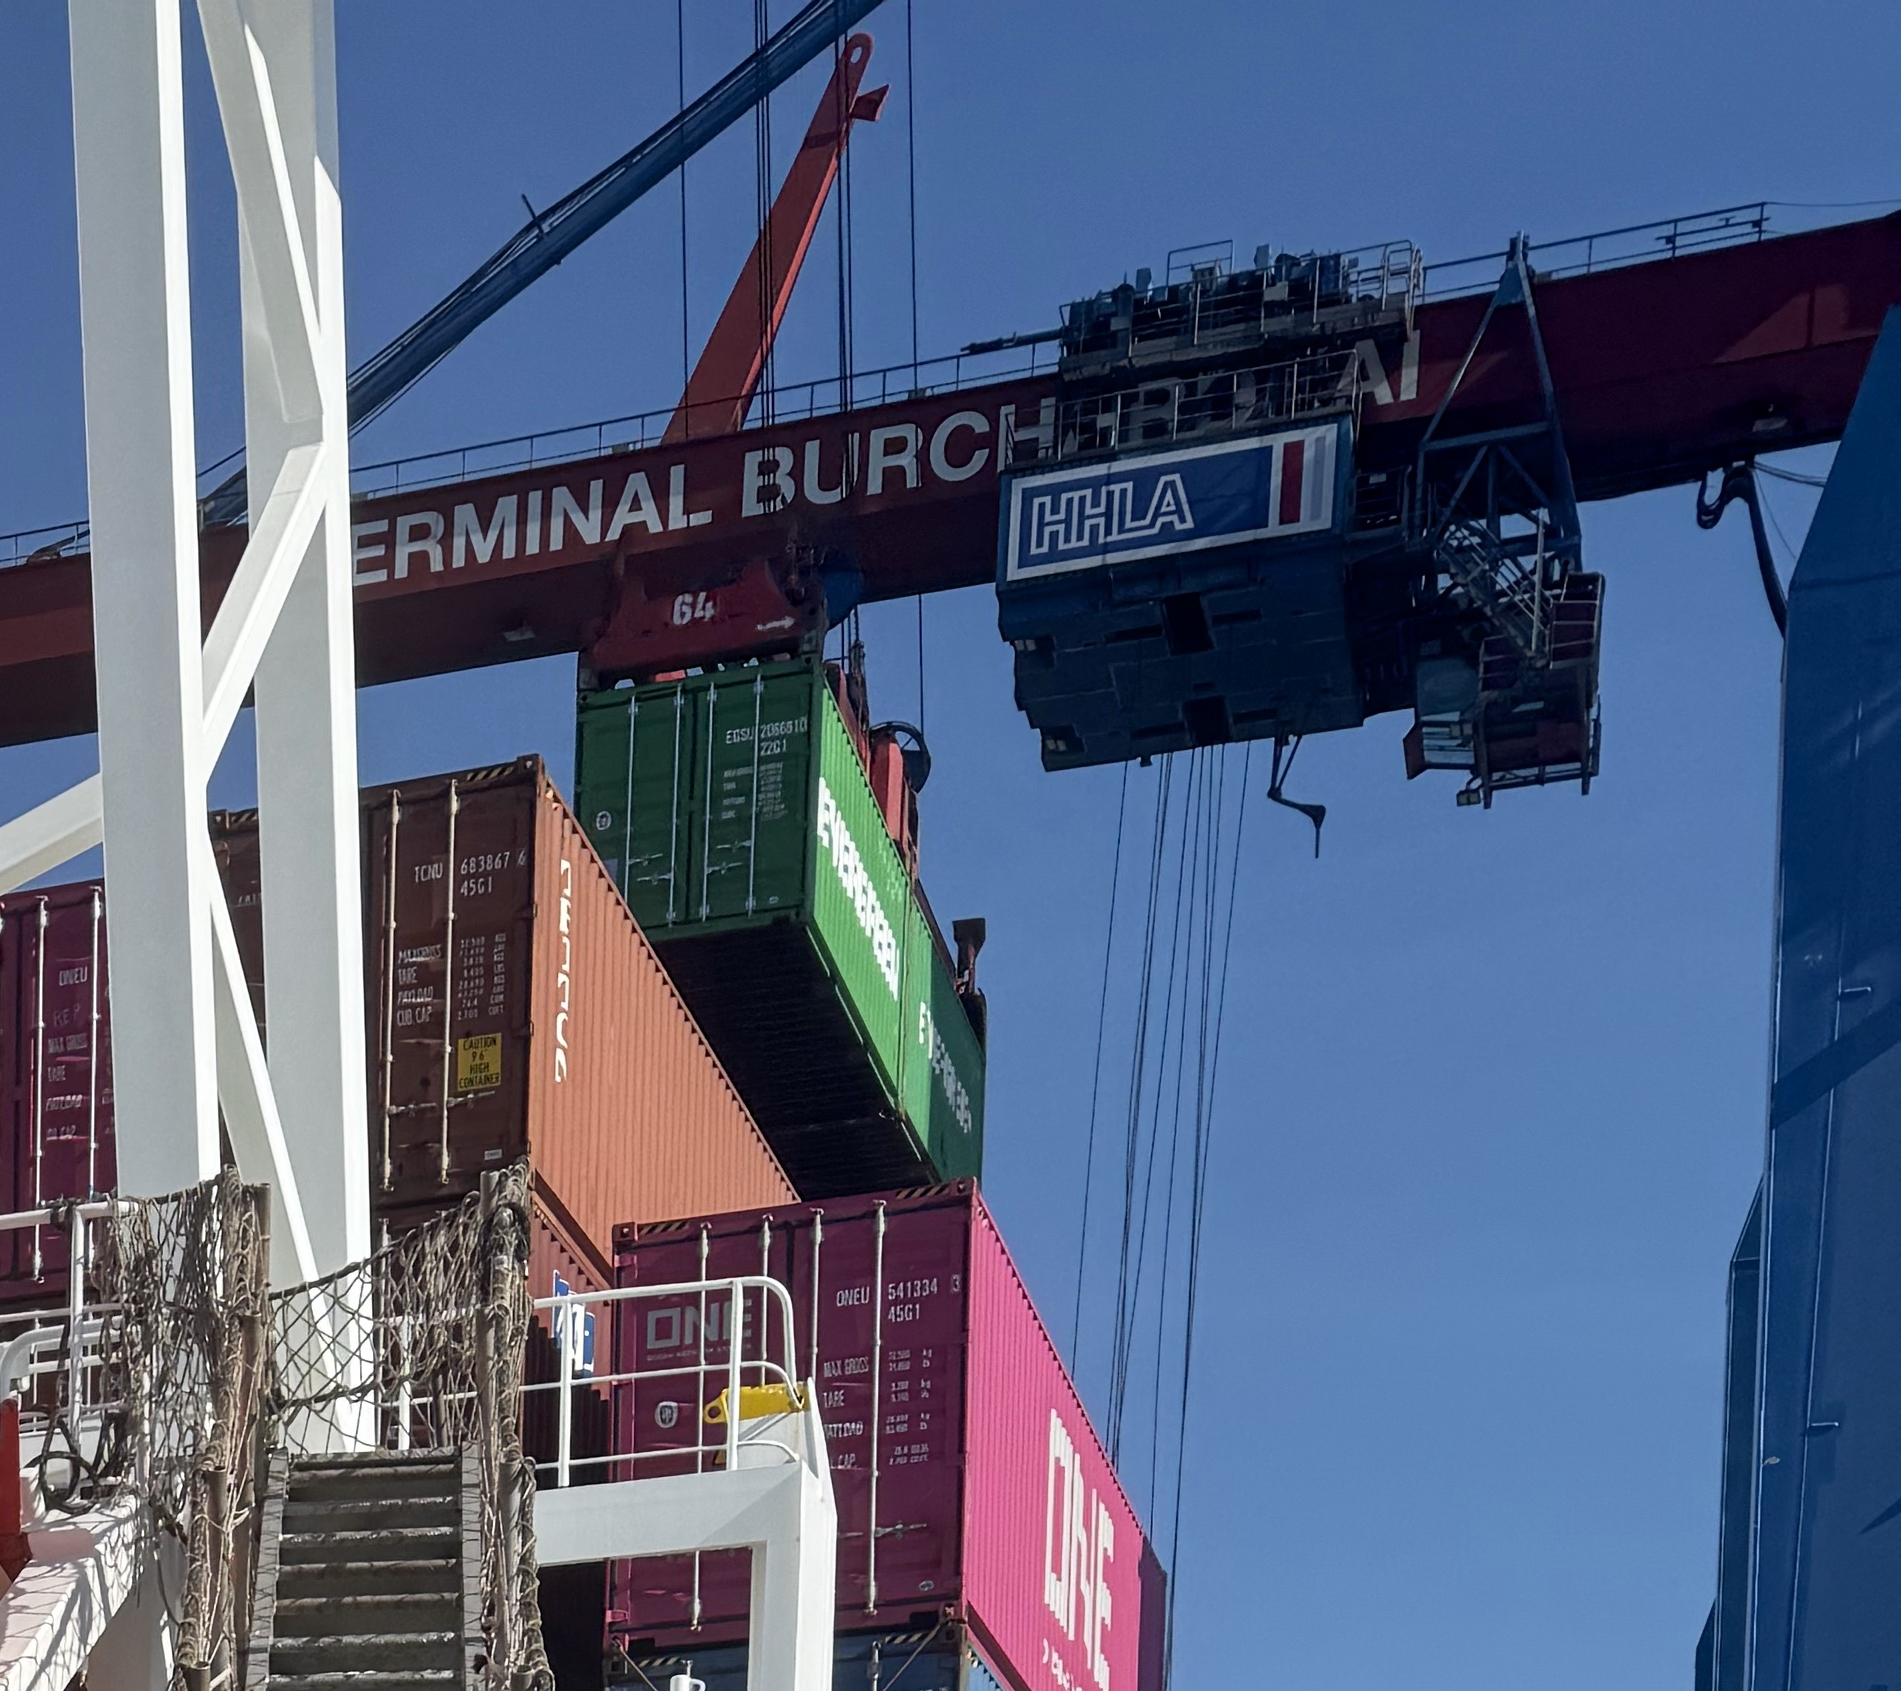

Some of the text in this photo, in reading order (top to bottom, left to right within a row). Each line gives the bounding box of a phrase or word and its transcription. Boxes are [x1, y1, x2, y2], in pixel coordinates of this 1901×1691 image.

[352, 463, 712, 585] ERMINAL
[1030, 473, 1195, 555] HHLA
[673, 592, 715, 625] 64
[414, 863, 443, 883] TCNU
[460, 851, 510, 875] 683867
[460, 876, 492, 896] 45G1
[59, 966, 88, 987] ONEU
[463, 1036, 497, 1051] CAUTION
[469, 1063, 490, 1074] HIGH
[459, 1072, 500, 1089] CONTAINER
[837, 1285, 870, 1307] ONEU
[888, 1277, 938, 1300] 541334
[888, 1303, 921, 1322] 45G1
[647, 1299, 752, 1350] ONE
[824, 1390, 845, 1408] TARE
